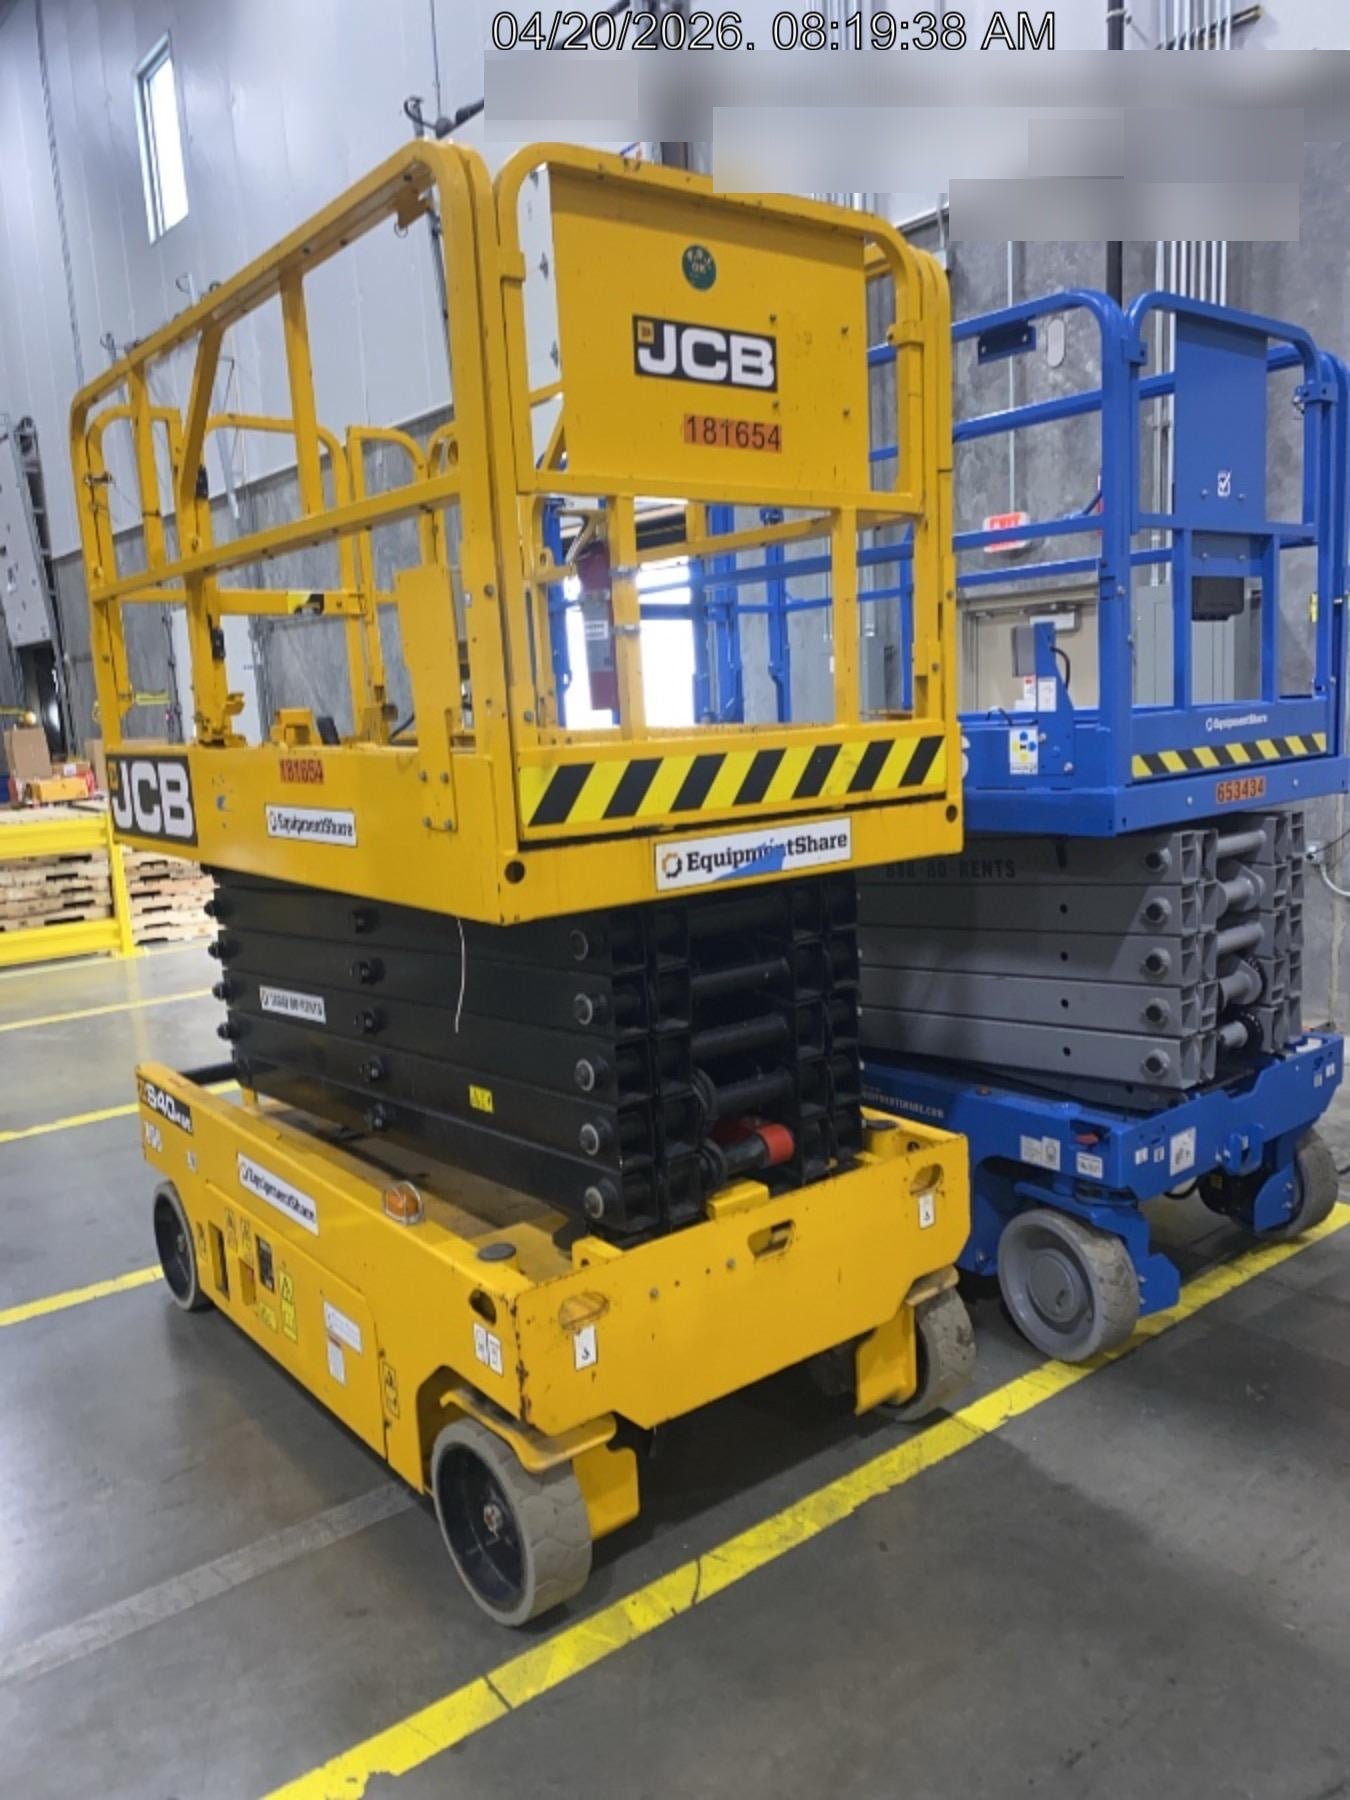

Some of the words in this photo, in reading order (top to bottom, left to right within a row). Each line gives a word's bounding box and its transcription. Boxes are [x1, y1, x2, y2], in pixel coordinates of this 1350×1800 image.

[637, 323, 775, 388] JCB
[687, 415, 780, 451] 181654
[112, 760, 195, 838] JCB
